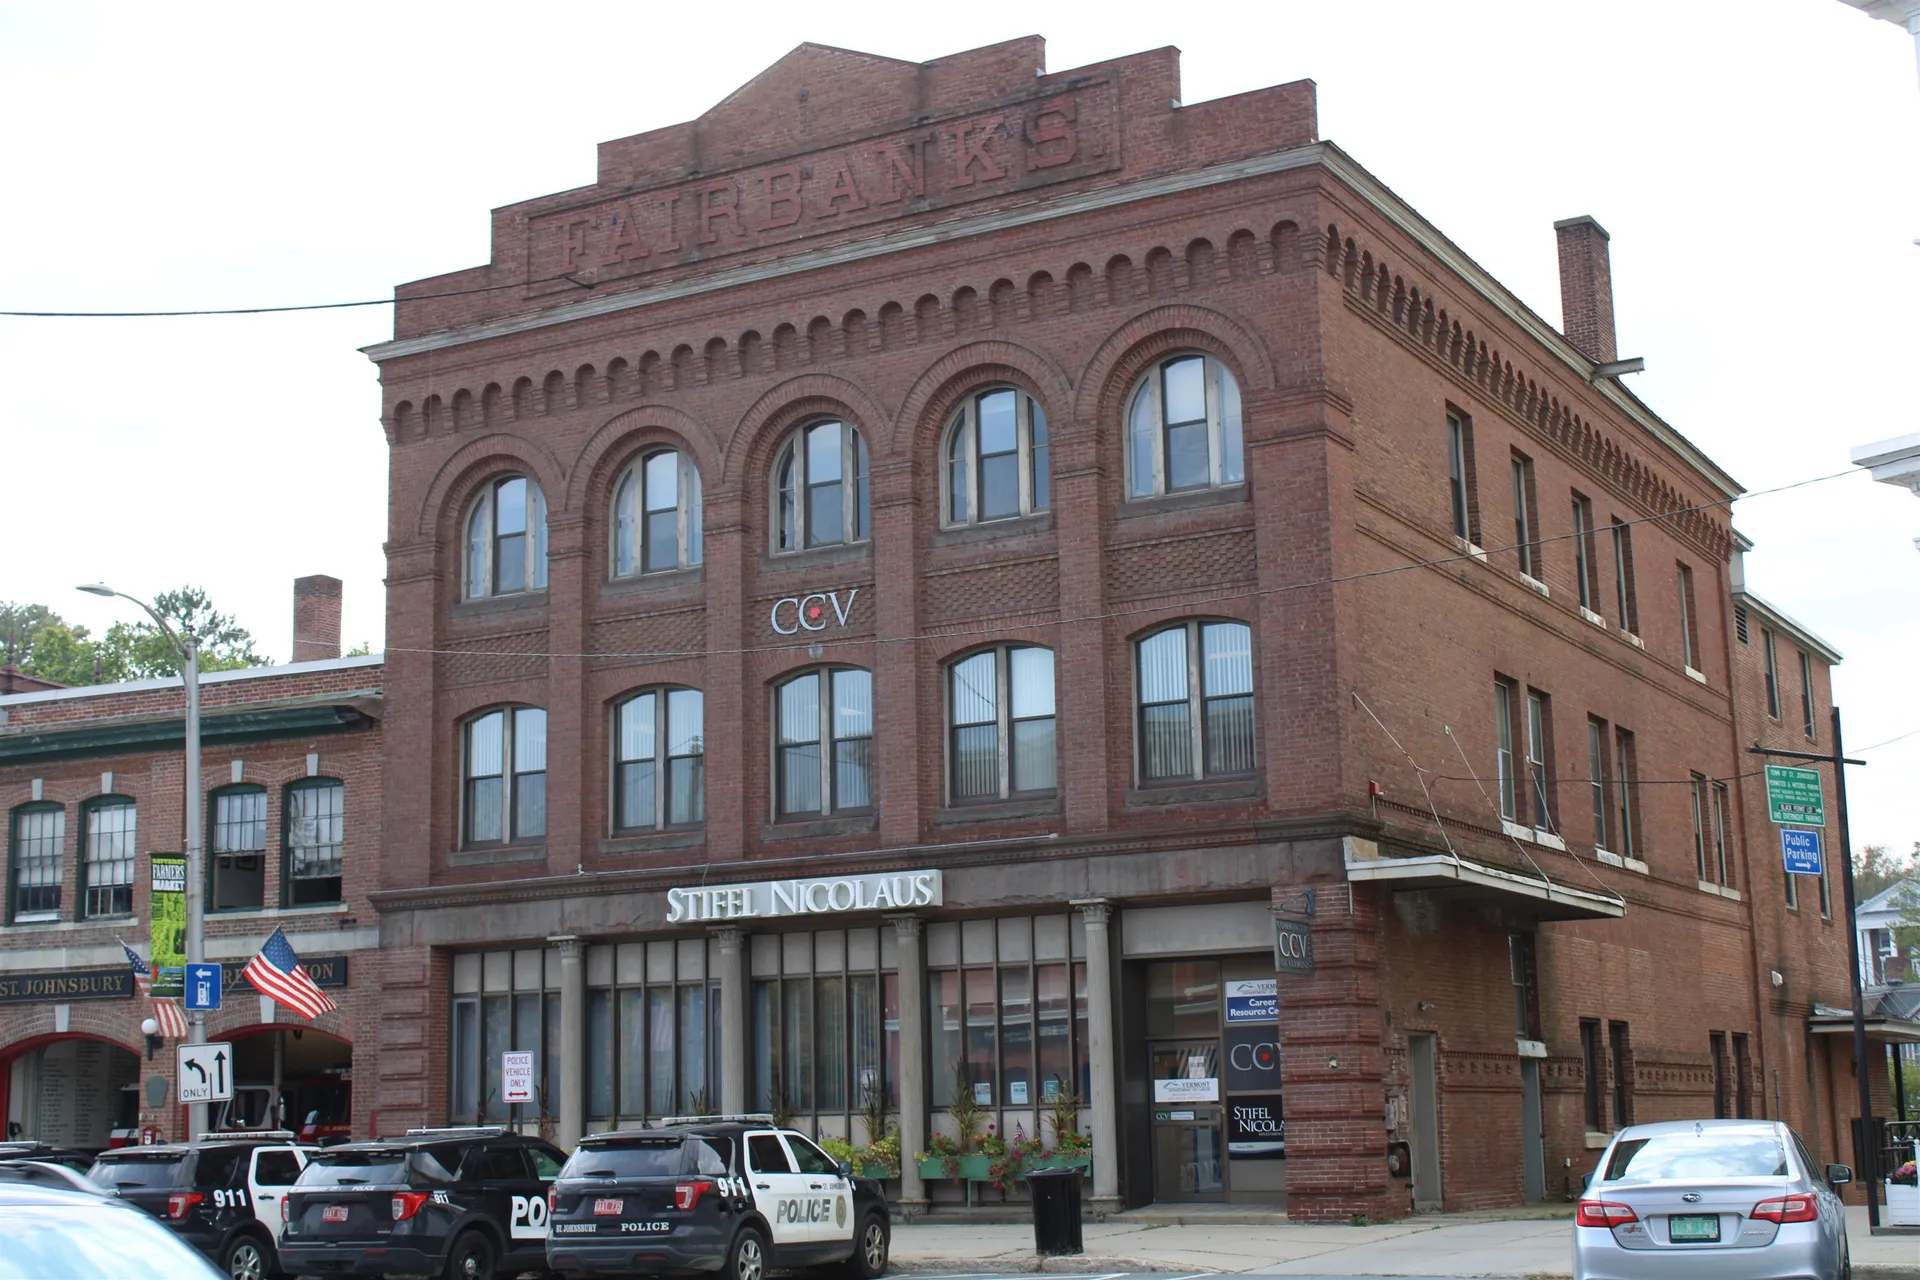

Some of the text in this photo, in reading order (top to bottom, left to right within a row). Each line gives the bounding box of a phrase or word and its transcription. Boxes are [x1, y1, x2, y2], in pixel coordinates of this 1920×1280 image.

[555, 105, 1078, 273] FAIRBANKS
[771, 589, 859, 634] CCV
[1785, 834, 1810, 847] Public
[1787, 848, 1817, 863] Parking
[152, 864, 185, 880] FARMERS
[152, 880, 185, 891] MARKET
[667, 875, 934, 922] STIFEL NICOLAUS
[1280, 932, 1307, 958] CCV
[22, 975, 125, 995] JOHNSBURY
[1231, 1008, 1266, 1016] Resource
[507, 1056, 528, 1065] POLICE
[506, 1068, 531, 1076] VEHICLE
[510, 1079, 526, 1088] ONLY
[183, 1088, 208, 1098] ONLY
[1233, 1106, 1271, 1120] STIFEL
[1239, 1119, 1284, 1132] NICOLA
[717, 1177, 747, 1198] 911
[213, 1188, 247, 1208] 911
[433, 1194, 450, 1204] 911
[777, 1199, 831, 1223] POLICE
[563, 1224, 597, 1233] JOHNSBURY
[621, 1222, 669, 1232] POLICE
